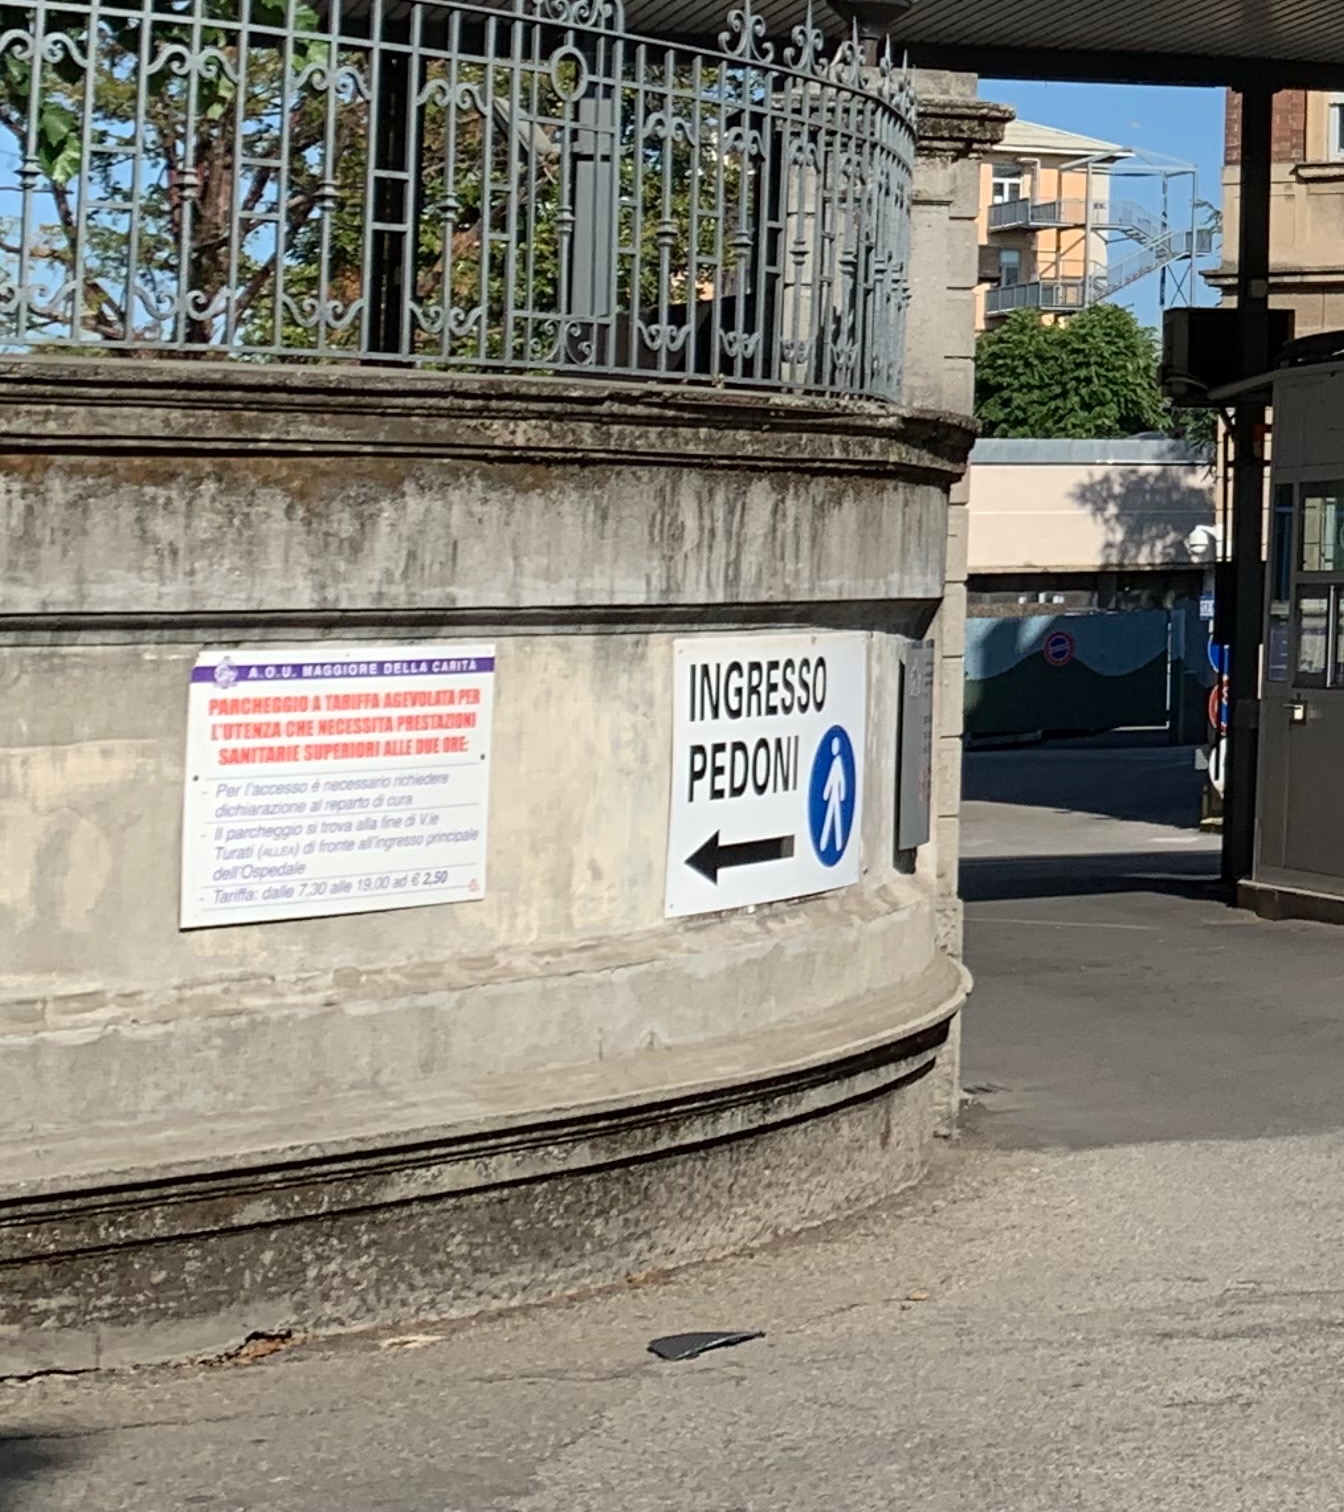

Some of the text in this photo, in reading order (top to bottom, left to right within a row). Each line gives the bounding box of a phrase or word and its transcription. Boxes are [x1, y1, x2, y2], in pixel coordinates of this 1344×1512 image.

[248, 666, 297, 679] A.O.U.
[302, 662, 378, 677] MAGGIORE
[383, 661, 428, 675] DELLA
[208, 688, 480, 716] PARCHEGGIO A TARIFFA AGEVOLATA PER
[689, 656, 827, 722] INGRESSO
[210, 712, 477, 741] L'UTENZA CHE NECESSITA PRESTAZIONI
[218, 745, 300, 766] SANITARIE
[304, 740, 380, 761] SUPERIORI
[383, 739, 412, 757] ALLE
[415, 737, 440, 754] DUE
[687, 735, 799, 803] PEDONI
[215, 783, 242, 797] Per
[244, 782, 308, 796] l'accesso
[323, 775, 391, 792] necessario
[394, 773, 449, 787] richiedere
[214, 794, 413, 818] dichiarazione al reparto di cura
[225, 824, 303, 843] parcheggio
[305, 822, 318, 834] si
[320, 821, 353, 834] trova
[355, 817, 377, 831] alla
[380, 814, 402, 829] fine
[404, 813, 415, 827] di
[214, 845, 254, 861] Turati
[302, 840, 315, 855] di
[318, 838, 356, 853] fronte
[358, 834, 425, 852] all'ingresso
[425, 828, 479, 847] principale
[212, 861, 306, 882] dell'Ospedale
[262, 885, 295, 900] dalle
[329, 879, 353, 894] alle
[392, 873, 408, 889] ad
[411, 871, 421, 886] €
